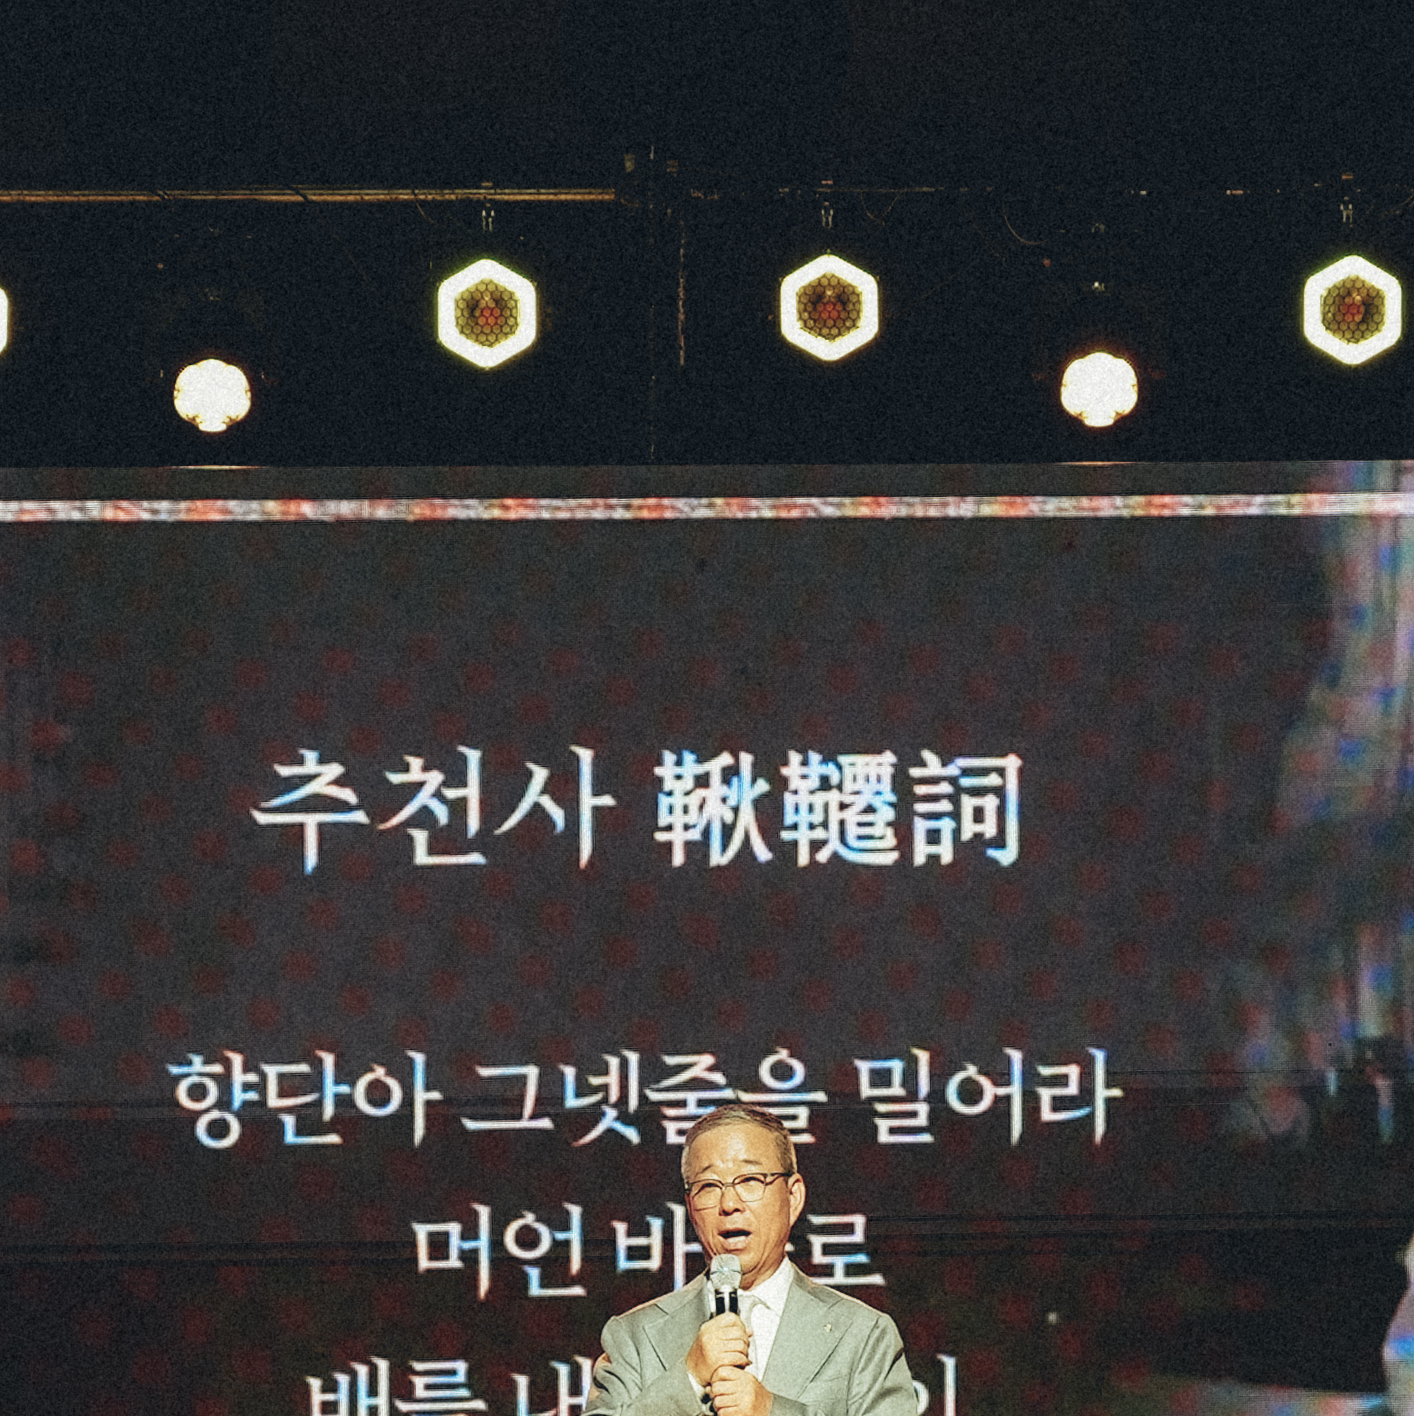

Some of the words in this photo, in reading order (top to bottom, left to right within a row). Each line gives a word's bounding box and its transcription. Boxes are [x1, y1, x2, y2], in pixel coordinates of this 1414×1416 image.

[249, 745, 618, 875] 추천사
[652, 748, 1023, 868] 鞦韆詞
[167, 1050, 443, 1150] 향단아
[461, 1046, 828, 1147] 그넷줄을
[853, 1046, 1124, 1145] 밀어라
[411, 1202, 586, 1299] 머언
[611, 1201, 886, 1290] 바로
